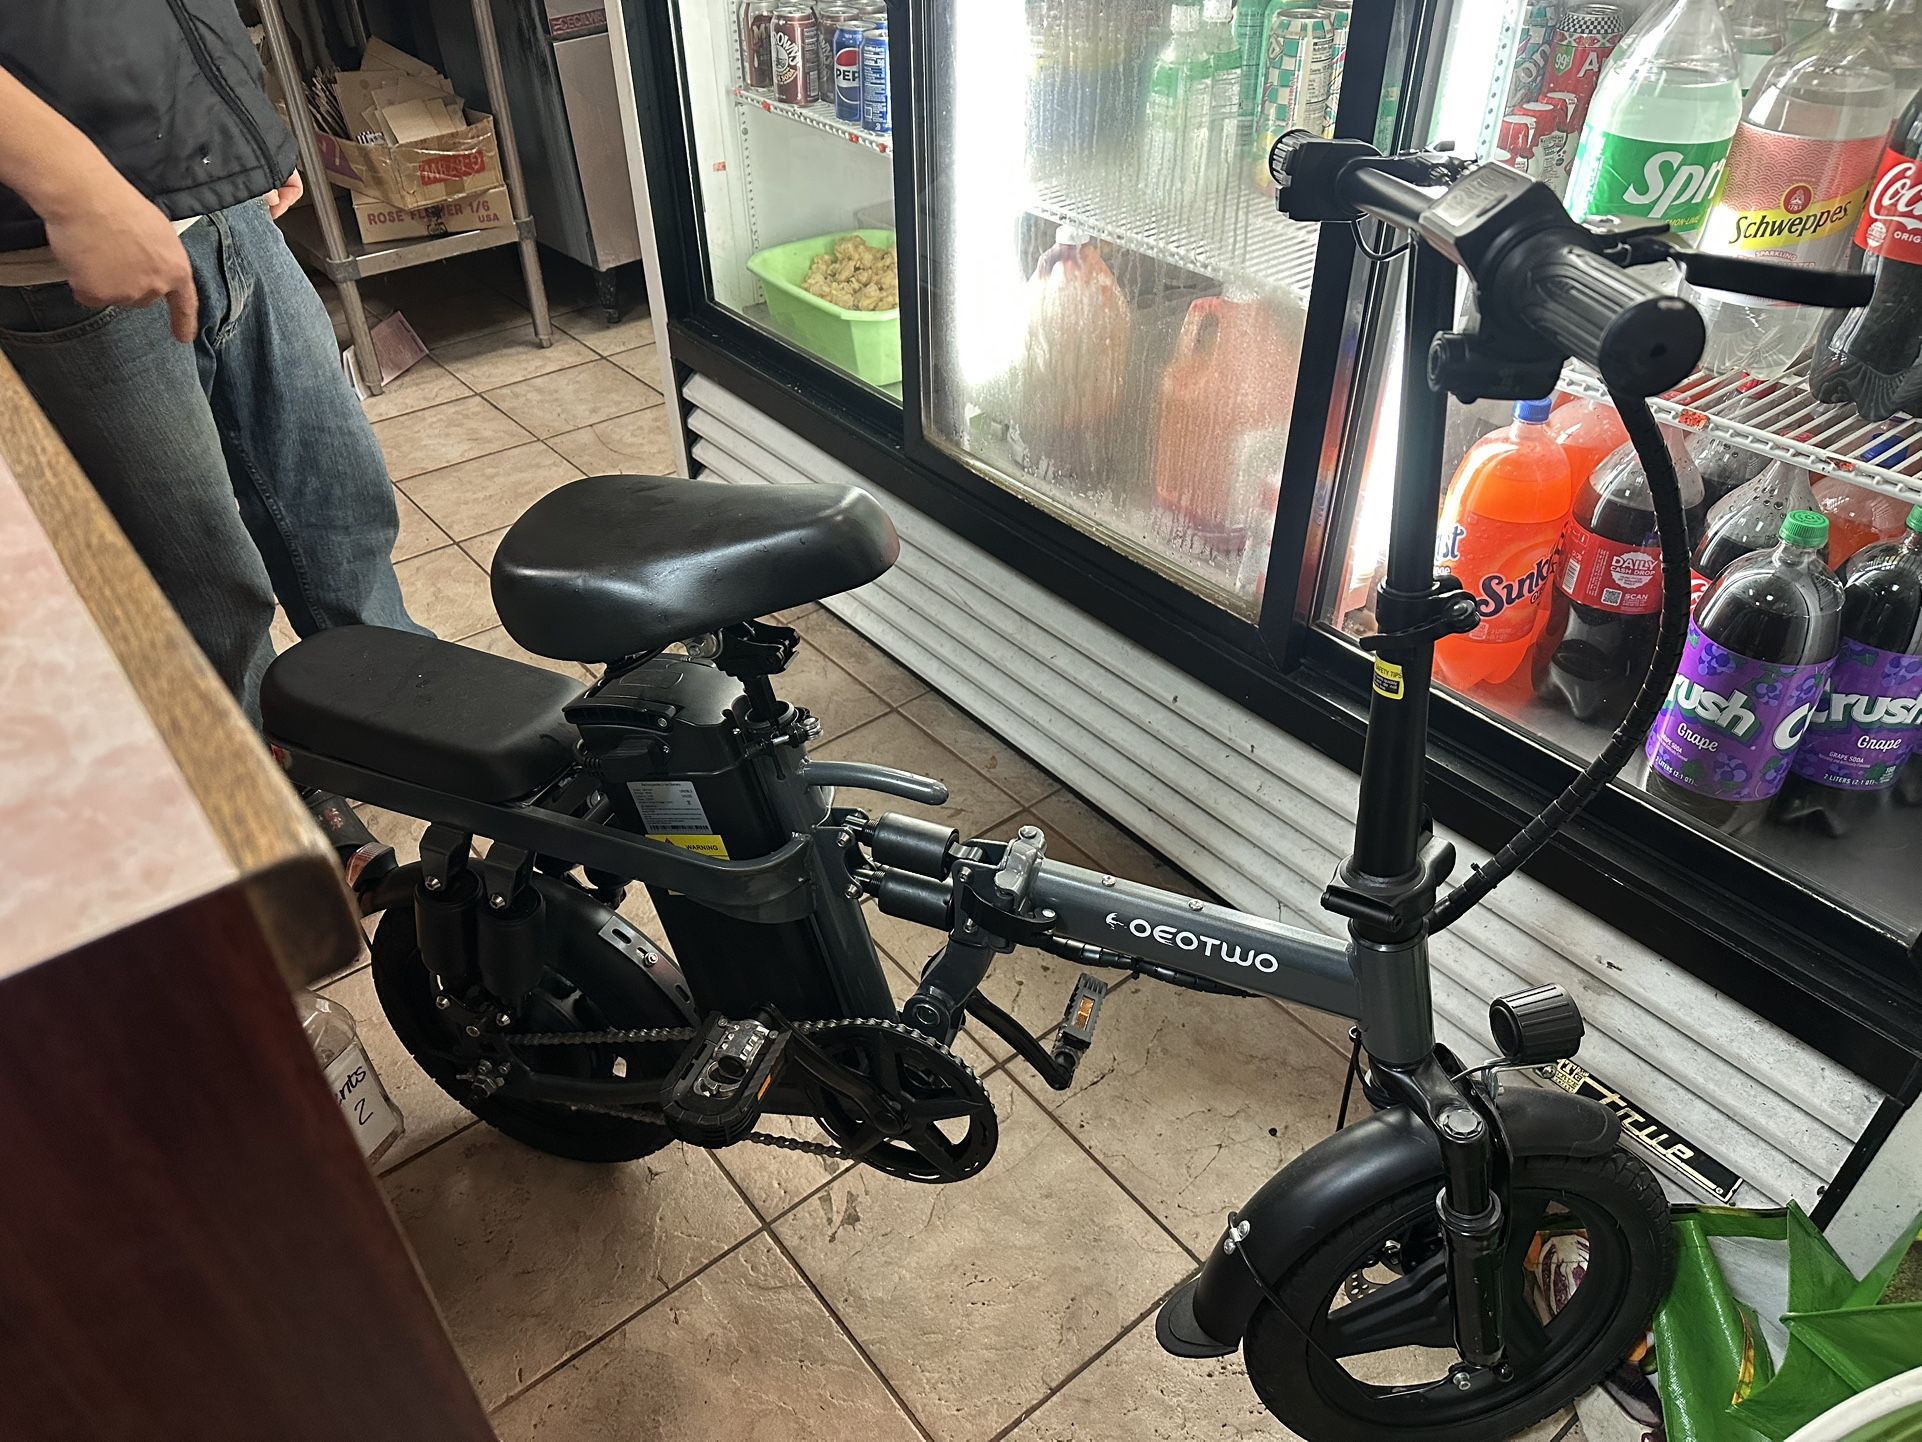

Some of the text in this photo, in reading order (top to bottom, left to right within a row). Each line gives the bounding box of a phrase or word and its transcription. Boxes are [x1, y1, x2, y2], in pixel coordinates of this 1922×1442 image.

[367, 211, 403, 225] ROSE
[467, 200, 490, 213] 1/6
[478, 213, 499, 224] USA
[1728, 200, 1852, 244] Schweppes
[1610, 566, 1631, 575] CASH
[1611, 555, 1658, 571] DAILY
[1677, 722, 1718, 752] Grape
[1857, 735, 1902, 753] Grape
[1829, 774, 1851, 785] LITERS
